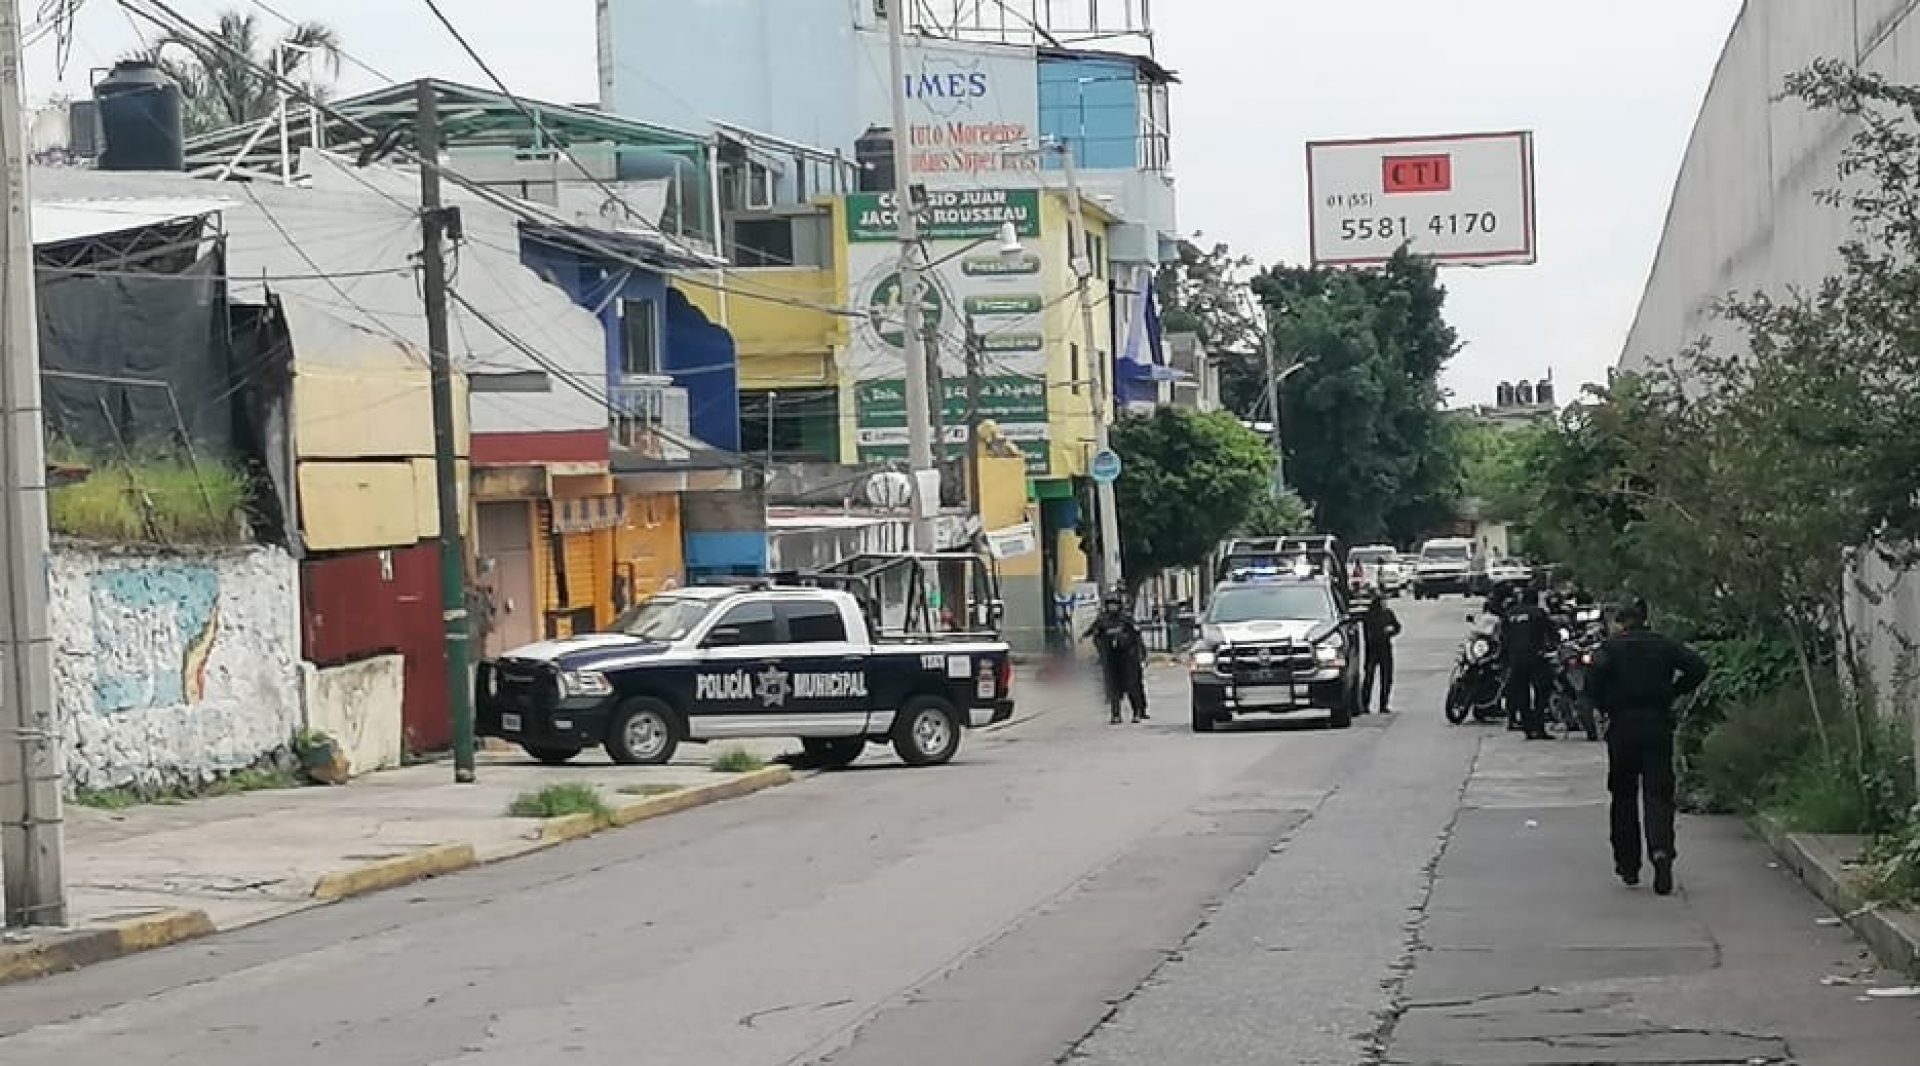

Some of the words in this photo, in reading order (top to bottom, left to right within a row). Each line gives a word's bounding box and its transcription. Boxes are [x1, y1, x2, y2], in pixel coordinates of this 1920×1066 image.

[1392, 162, 1442, 185] CTI
[961, 190, 1007, 204] JUAN
[934, 206, 1028, 223] ROUSSEAU
[1341, 217, 1408, 240] 5581
[1429, 211, 1496, 234] 4170
[696, 668, 753, 699] POLICÍA
[794, 671, 868, 698] MUNICIPAL
